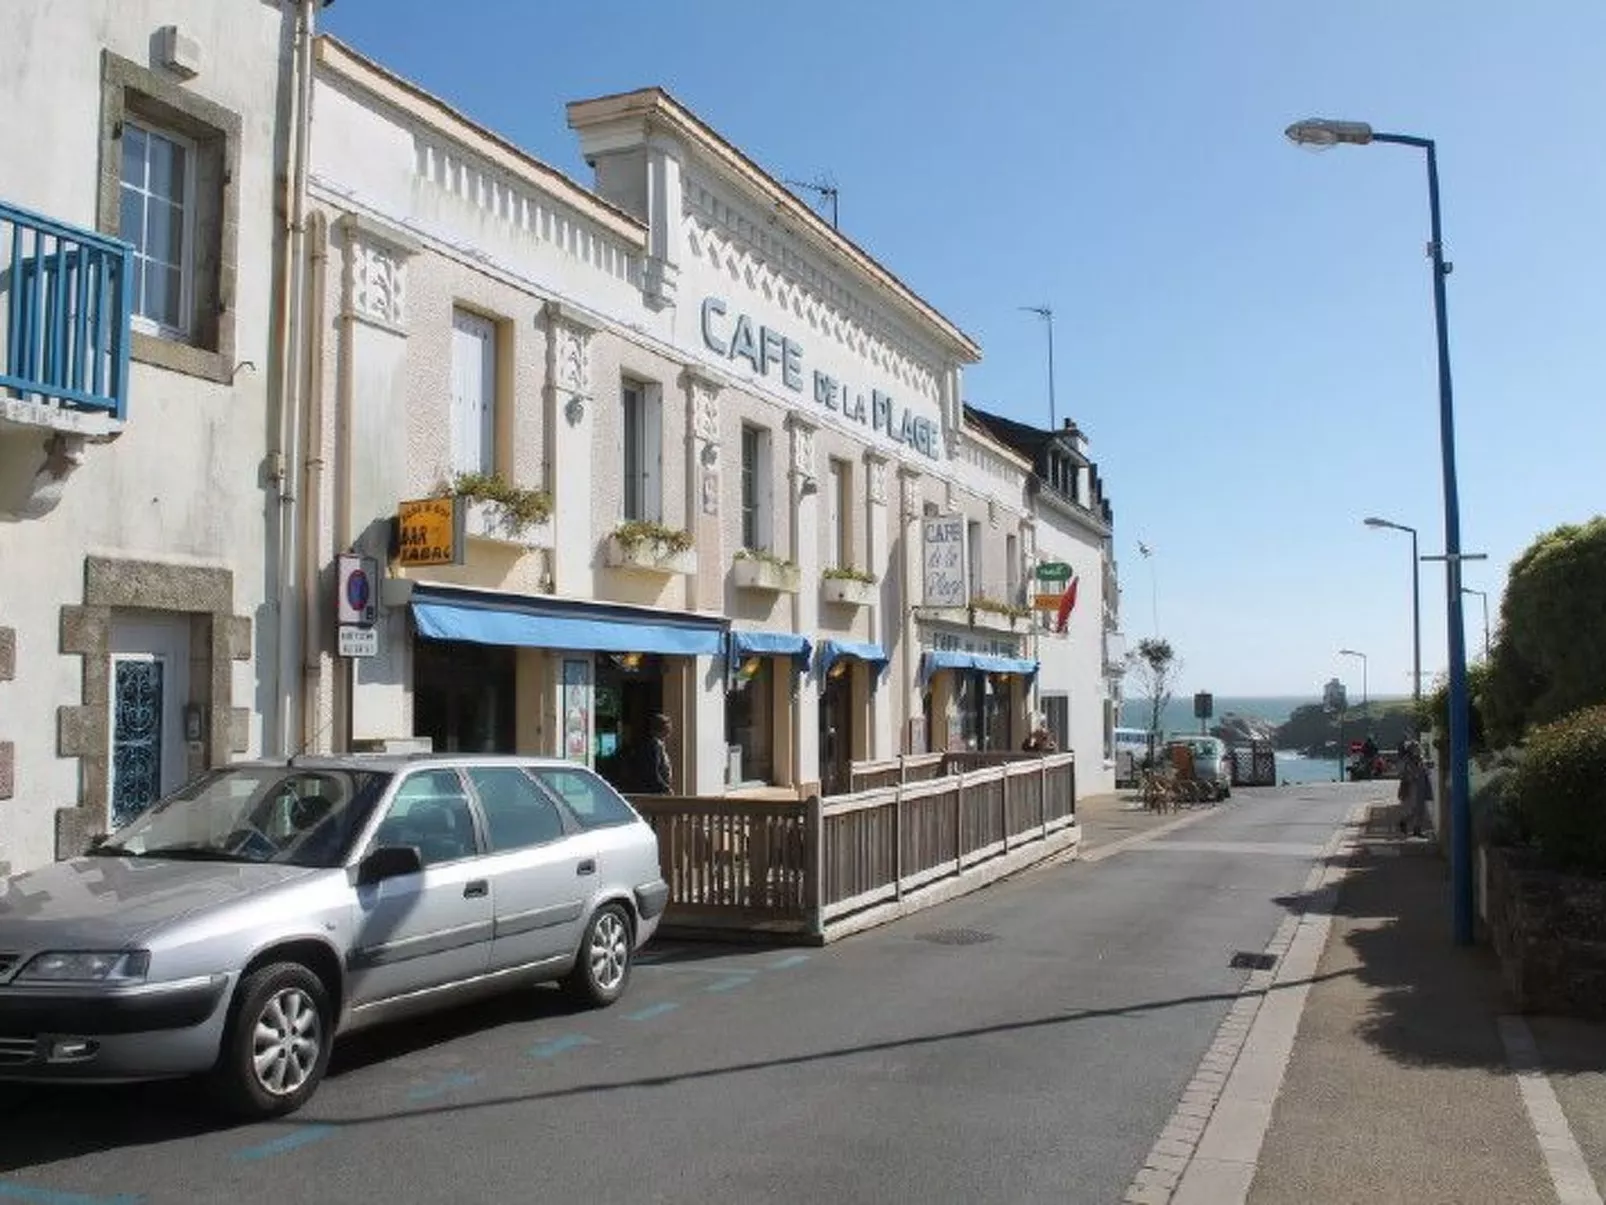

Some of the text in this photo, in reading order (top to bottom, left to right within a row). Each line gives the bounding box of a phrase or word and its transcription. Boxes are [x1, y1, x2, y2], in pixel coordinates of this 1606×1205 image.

[701, 297, 939, 461] CAFE DE LA PLAGE
[402, 526, 427, 546] BAR
[926, 522, 962, 543] CAFE
